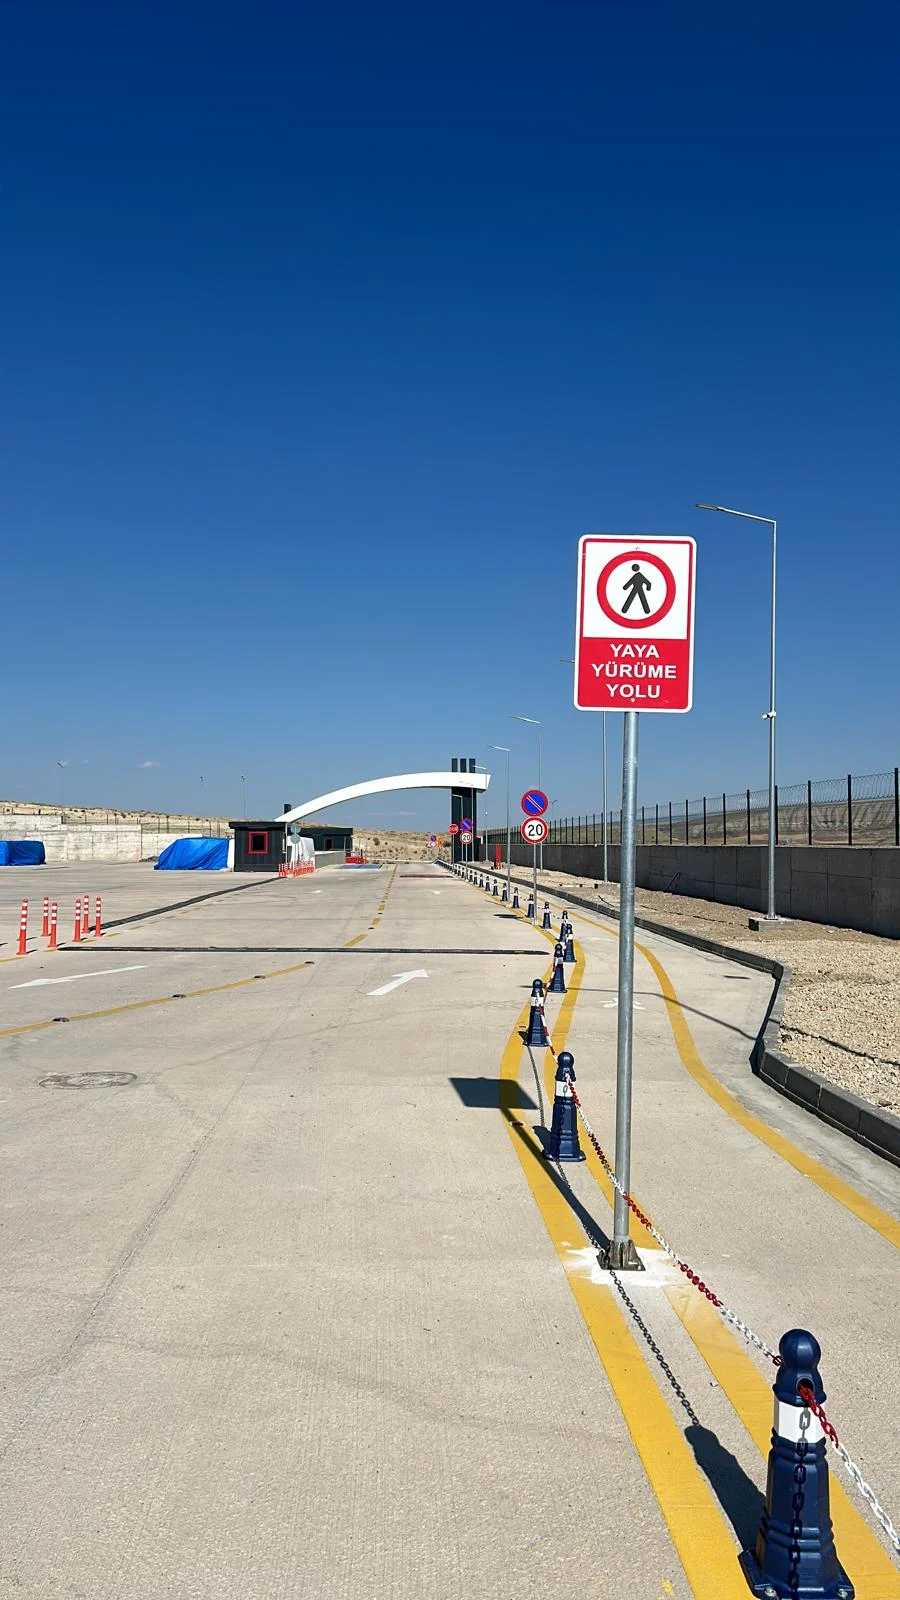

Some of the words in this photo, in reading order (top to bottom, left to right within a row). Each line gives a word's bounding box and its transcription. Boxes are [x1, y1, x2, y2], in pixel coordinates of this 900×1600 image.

[610, 644, 660, 658] YAYA
[591, 661, 677, 679] YÜRÜME
[606, 684, 660, 698] YOLU
[528, 824, 543, 836] 20
